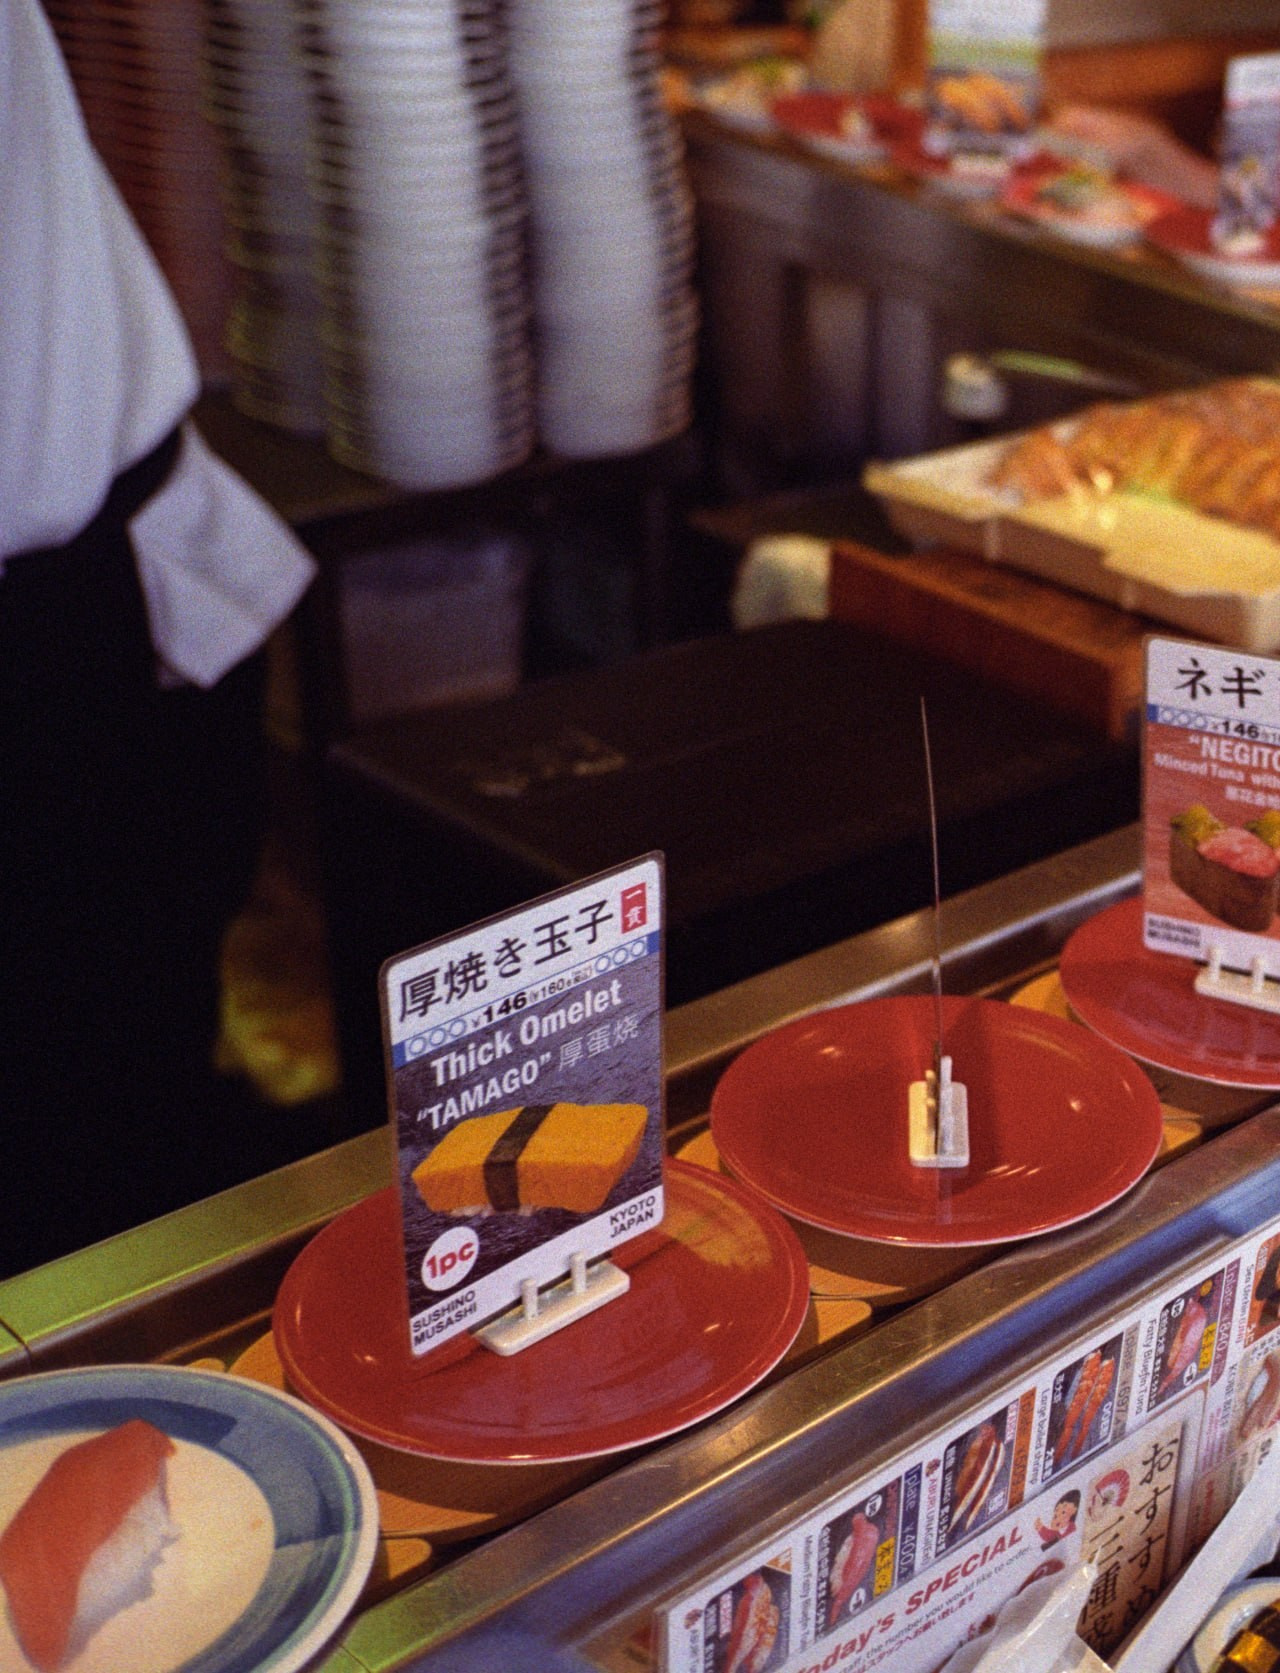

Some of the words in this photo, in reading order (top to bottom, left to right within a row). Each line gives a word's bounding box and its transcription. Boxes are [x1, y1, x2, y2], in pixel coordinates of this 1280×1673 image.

[1154, 753, 1207, 776] Minced
[1209, 764, 1245, 782] Tuna
[1250, 774, 1280, 790] with
[625, 889, 643, 928] 一貫
[400, 899, 613, 1022] 厚焼き玉子
[430, 1031, 512, 1087] Thick
[520, 979, 621, 1046] Omelet
[558, 1015, 641, 1072] 厚蛋烧
[610, 1196, 655, 1225] KYOTO
[611, 1209, 653, 1238] JAPAN
[426, 1242, 474, 1279] 1pc
[413, 1290, 476, 1333] SUSHINO
[414, 1303, 477, 1346] MUSASHI
[1143, 1316, 1157, 1350] Fatty
[1139, 1347, 1152, 1387] Bluefin
[1038, 1386, 1050, 1420] Large
[1134, 1386, 1147, 1416] Tuna
[1035, 1416, 1047, 1450] boiled
[1028, 1448, 1042, 1487] shrimp
[905, 1526, 1023, 1615] SPECIAL
[885, 1618, 922, 1645] number
